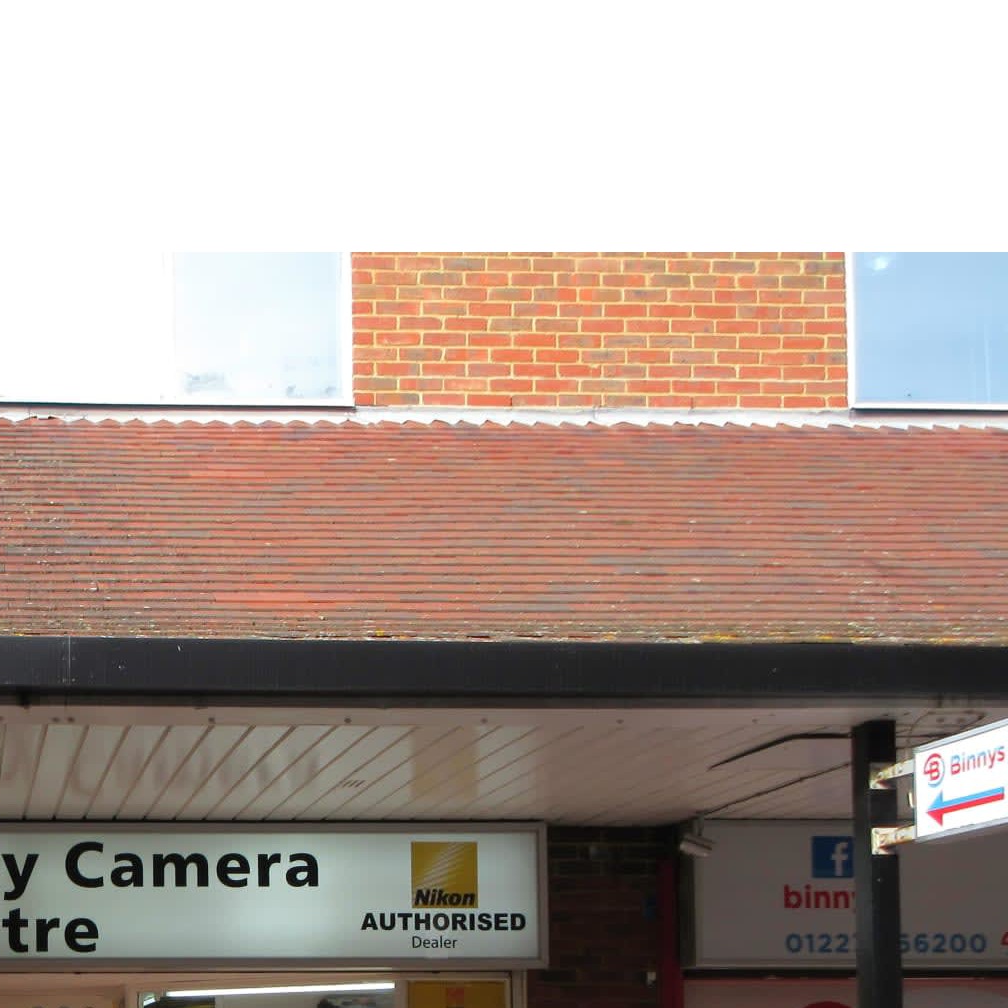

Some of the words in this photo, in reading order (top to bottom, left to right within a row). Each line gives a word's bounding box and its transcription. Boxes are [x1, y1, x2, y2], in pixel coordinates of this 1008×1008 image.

[950, 746, 1005, 776] Binnys
[64, 841, 319, 888] Camera
[414, 888, 476, 907] Nikon
[783, 885, 856, 910] binn
[361, 912, 527, 931] AUTHORISED
[411, 936, 457, 949] Dealer
[785, 933, 858, 954] 0122
[899, 933, 988, 954] 56200
